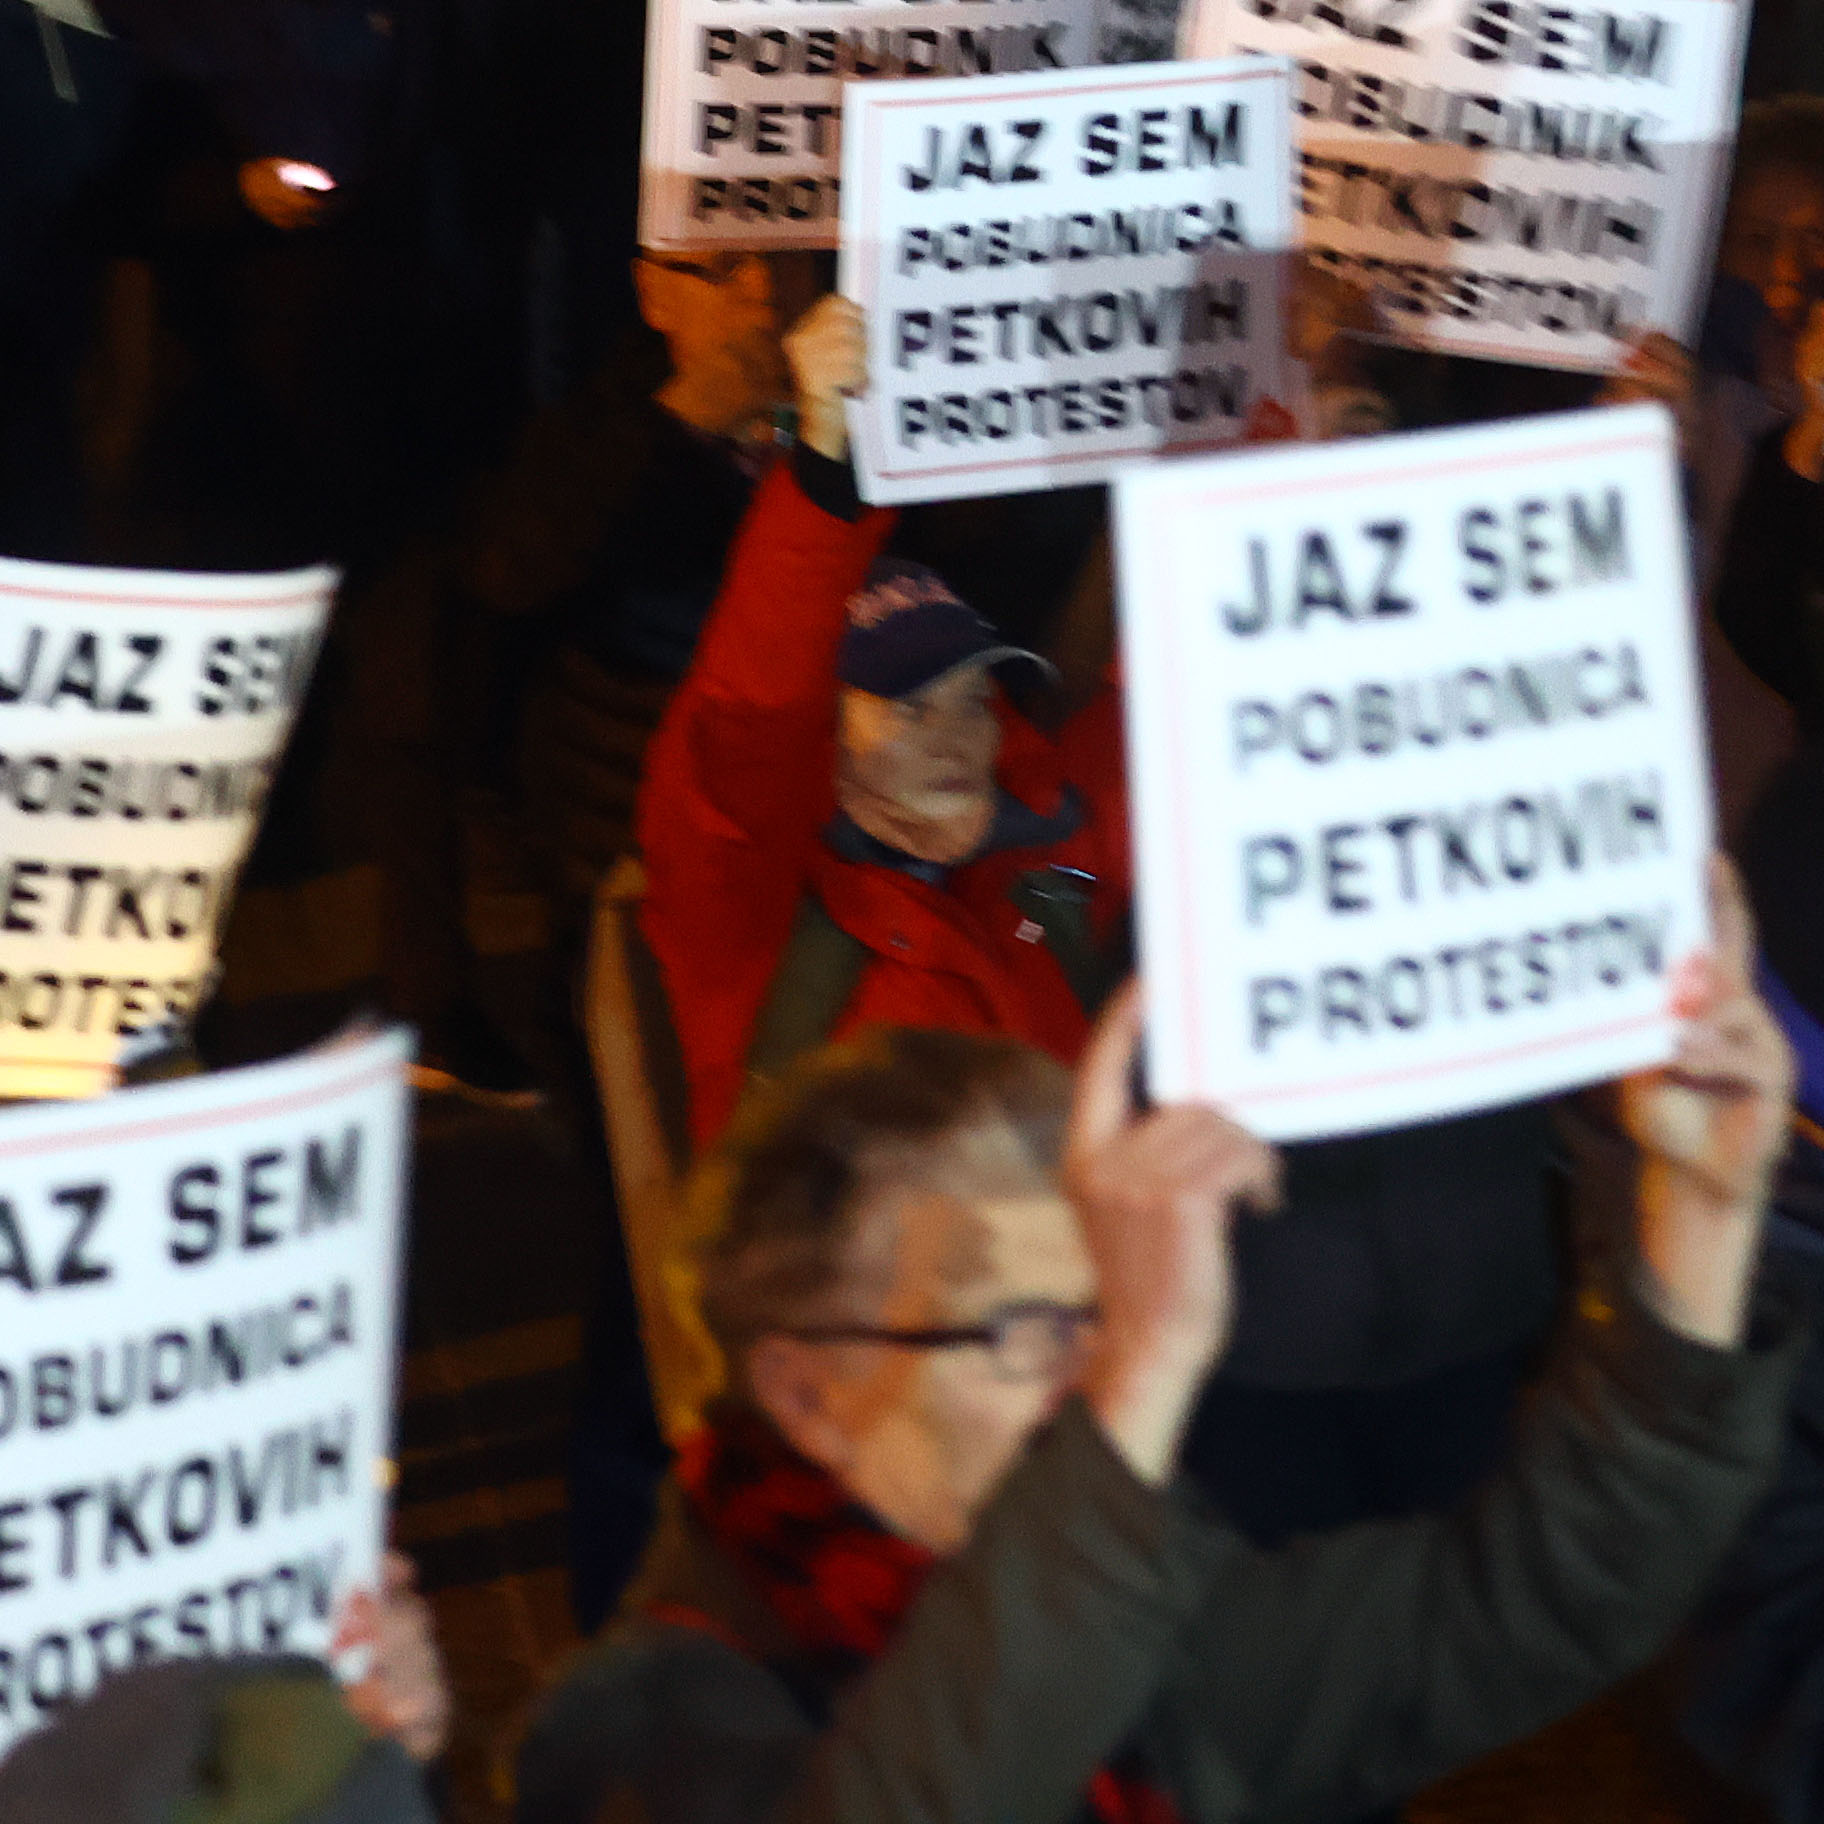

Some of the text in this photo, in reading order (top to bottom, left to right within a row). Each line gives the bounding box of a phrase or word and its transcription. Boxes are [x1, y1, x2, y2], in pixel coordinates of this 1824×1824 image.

[698, 23, 1069, 78] POBUDNIK
[900, 118, 1050, 194] JAZ
[1077, 99, 1249, 178] SEM
[1294, 58, 1664, 174] OBUDNIK
[898, 198, 1248, 277] POBUDNICA
[894, 279, 1252, 372] PETKOVIH
[894, 366, 1252, 453] PROTESTOV
[1222, 484, 1635, 640] JAZ SEM
[1232, 642, 1652, 773] POBUDNICA
[1240, 769, 1671, 930] PETKOVIH
[1246, 904, 1672, 1056] PROTESTOV
[166, 1121, 367, 1268] SEM
